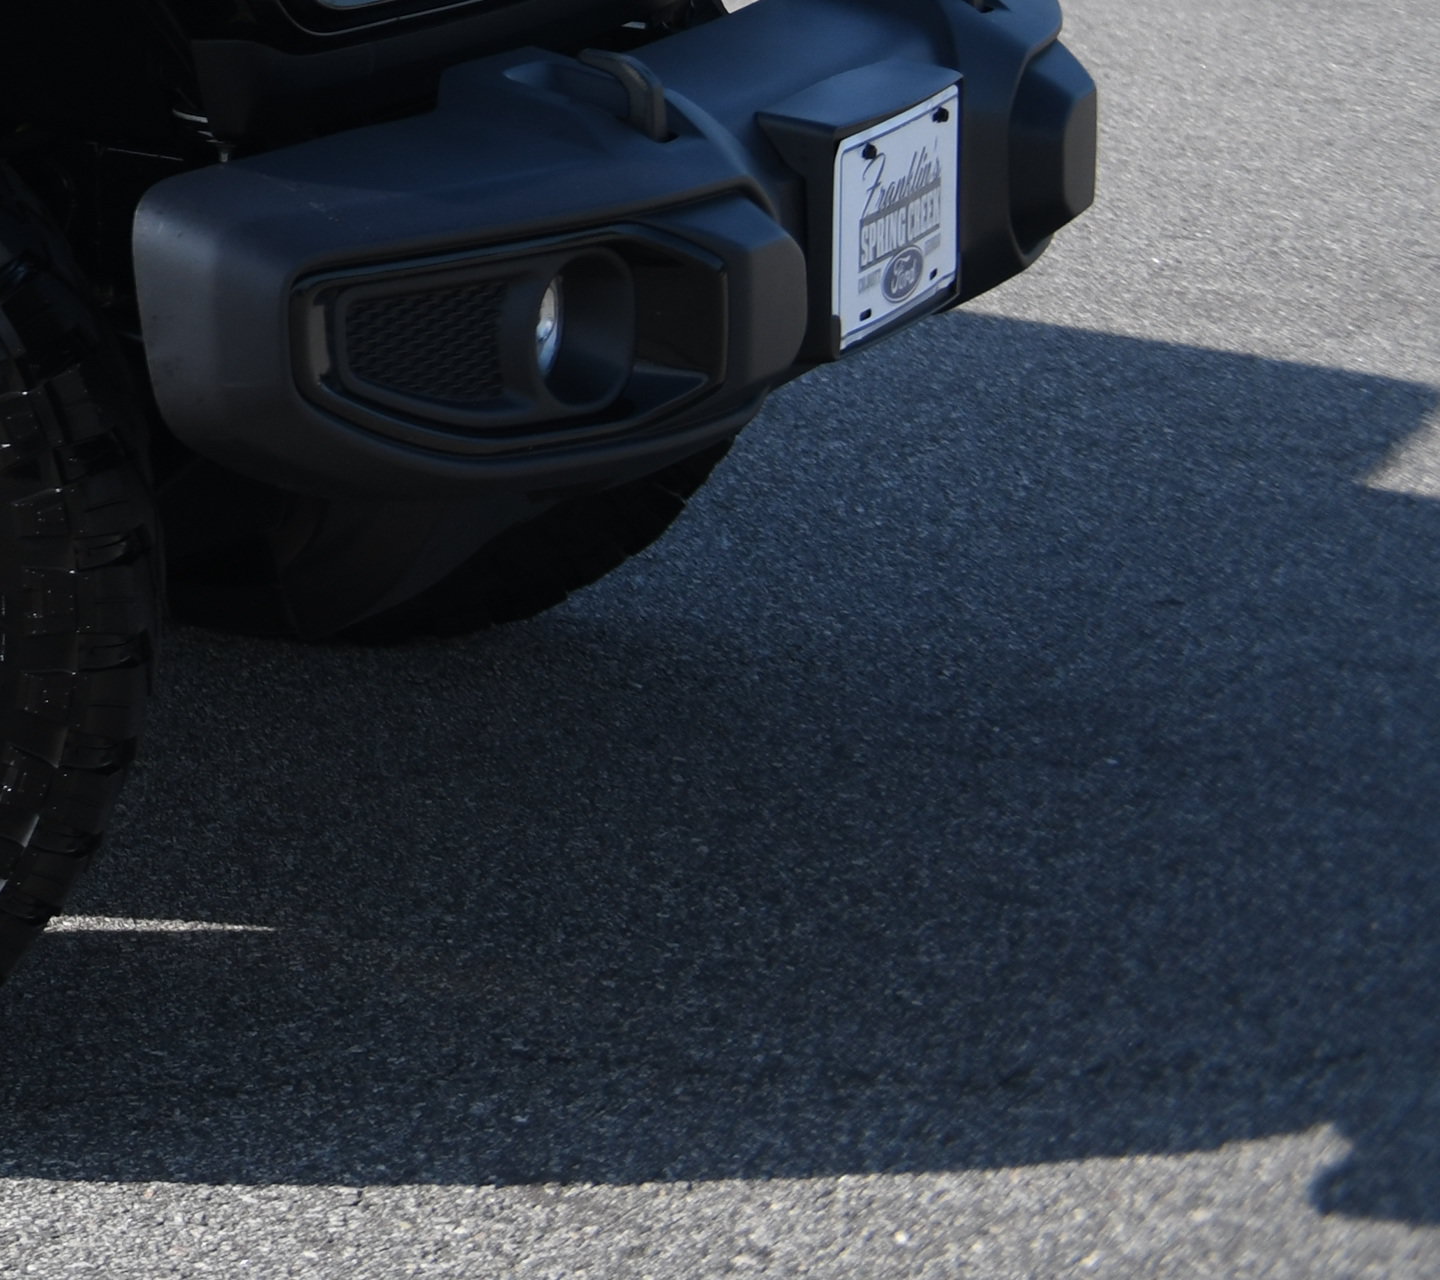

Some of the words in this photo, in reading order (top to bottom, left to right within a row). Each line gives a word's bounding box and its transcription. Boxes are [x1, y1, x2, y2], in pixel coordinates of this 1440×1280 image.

[860, 136, 942, 220] Franklin's
[859, 204, 907, 268] SPRING
[907, 187, 941, 243] CREEK
[891, 255, 918, 294] Ford
